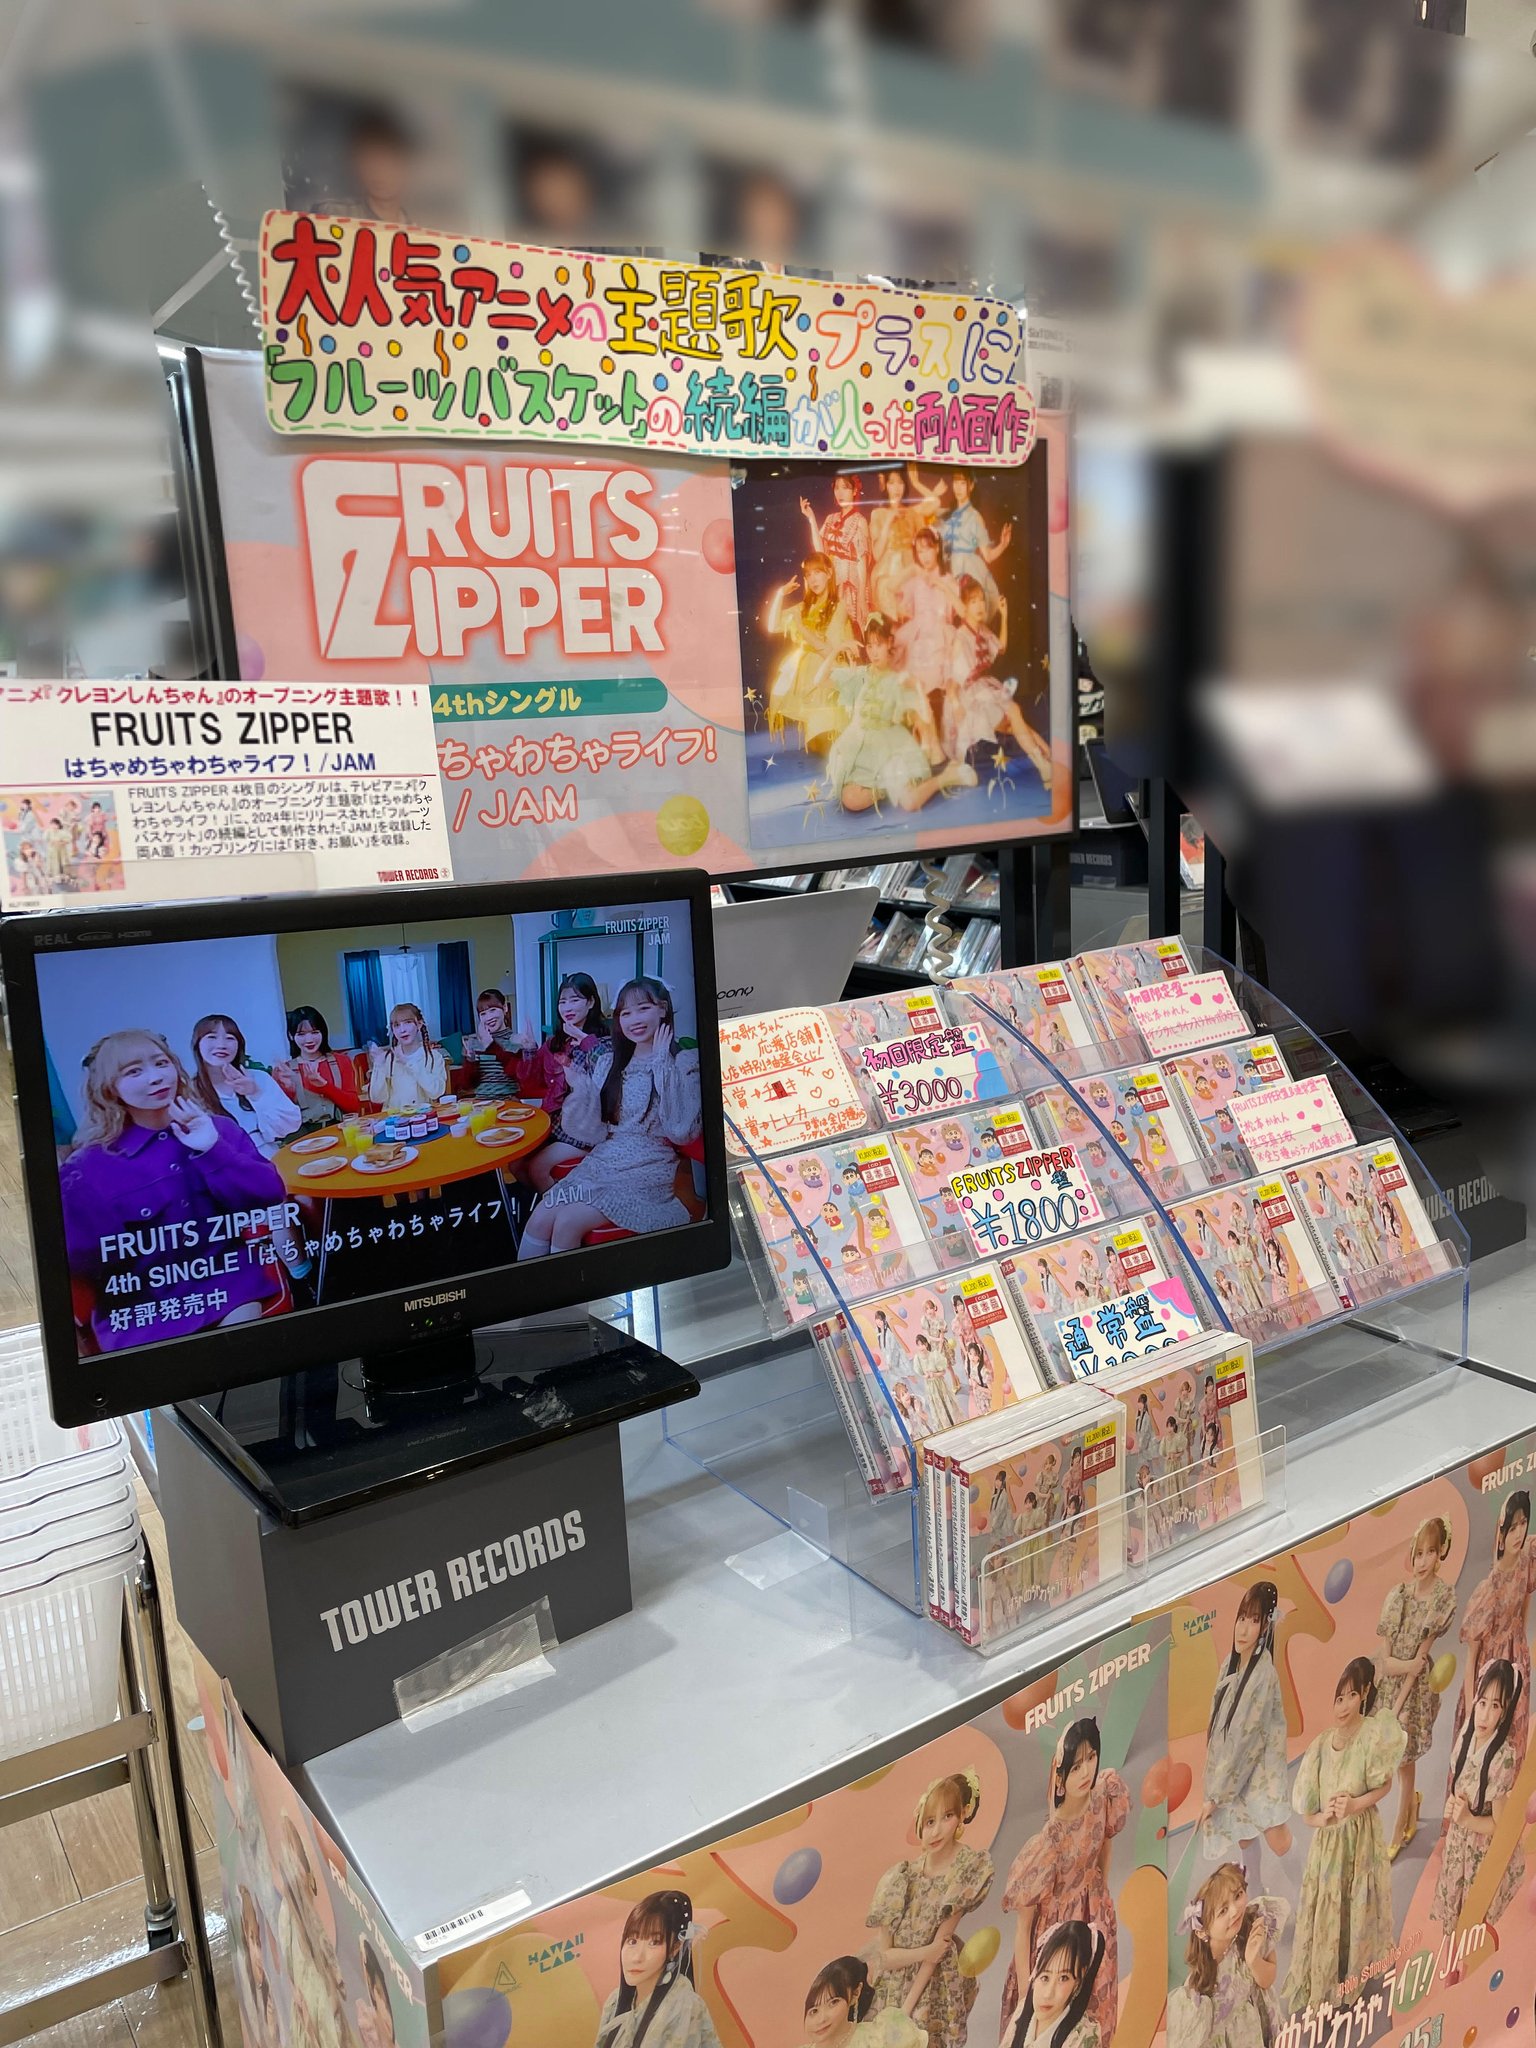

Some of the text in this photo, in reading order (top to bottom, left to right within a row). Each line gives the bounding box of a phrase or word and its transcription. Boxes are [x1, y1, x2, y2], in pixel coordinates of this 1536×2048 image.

[302, 460, 660, 562] FRUITS
[0, 684, 419, 706] ニメ『クレヨンしんちゃん』のオープニング主題歌！！
[91, 711, 354, 747] FRUITS ZIPPER
[128, 786, 177, 798] FRUITS
[182, 785, 228, 796] ZIPPER
[478, 783, 578, 828] JAM
[405, 867, 439, 881] RECORDS
[34, 932, 73, 947] REAL
[605, 915, 670, 934] FRUITS ZIPPER
[648, 932, 671, 946] JAM
[862, 1027, 975, 1071] 初回限定盤
[876, 1076, 963, 1115] ¥3000
[951, 1147, 1076, 1199] FRUITS ZIPPER
[99, 1201, 302, 1263] FRUITS ZIPPER
[971, 1192, 1080, 1250] ¥1800
[104, 1272, 142, 1296] 4th
[148, 1251, 240, 1288] SINGLE
[108, 1288, 229, 1333] 好評発売中
[403, 1288, 467, 1312] MITSUBISHI
[1063, 1293, 1167, 1360] 通常盤
[1481, 1457, 1524, 1495] FRUITS
[319, 1508, 587, 1653] TOWER RECORDS
[1024, 1642, 1151, 1736] FRUITS ZIPPER
